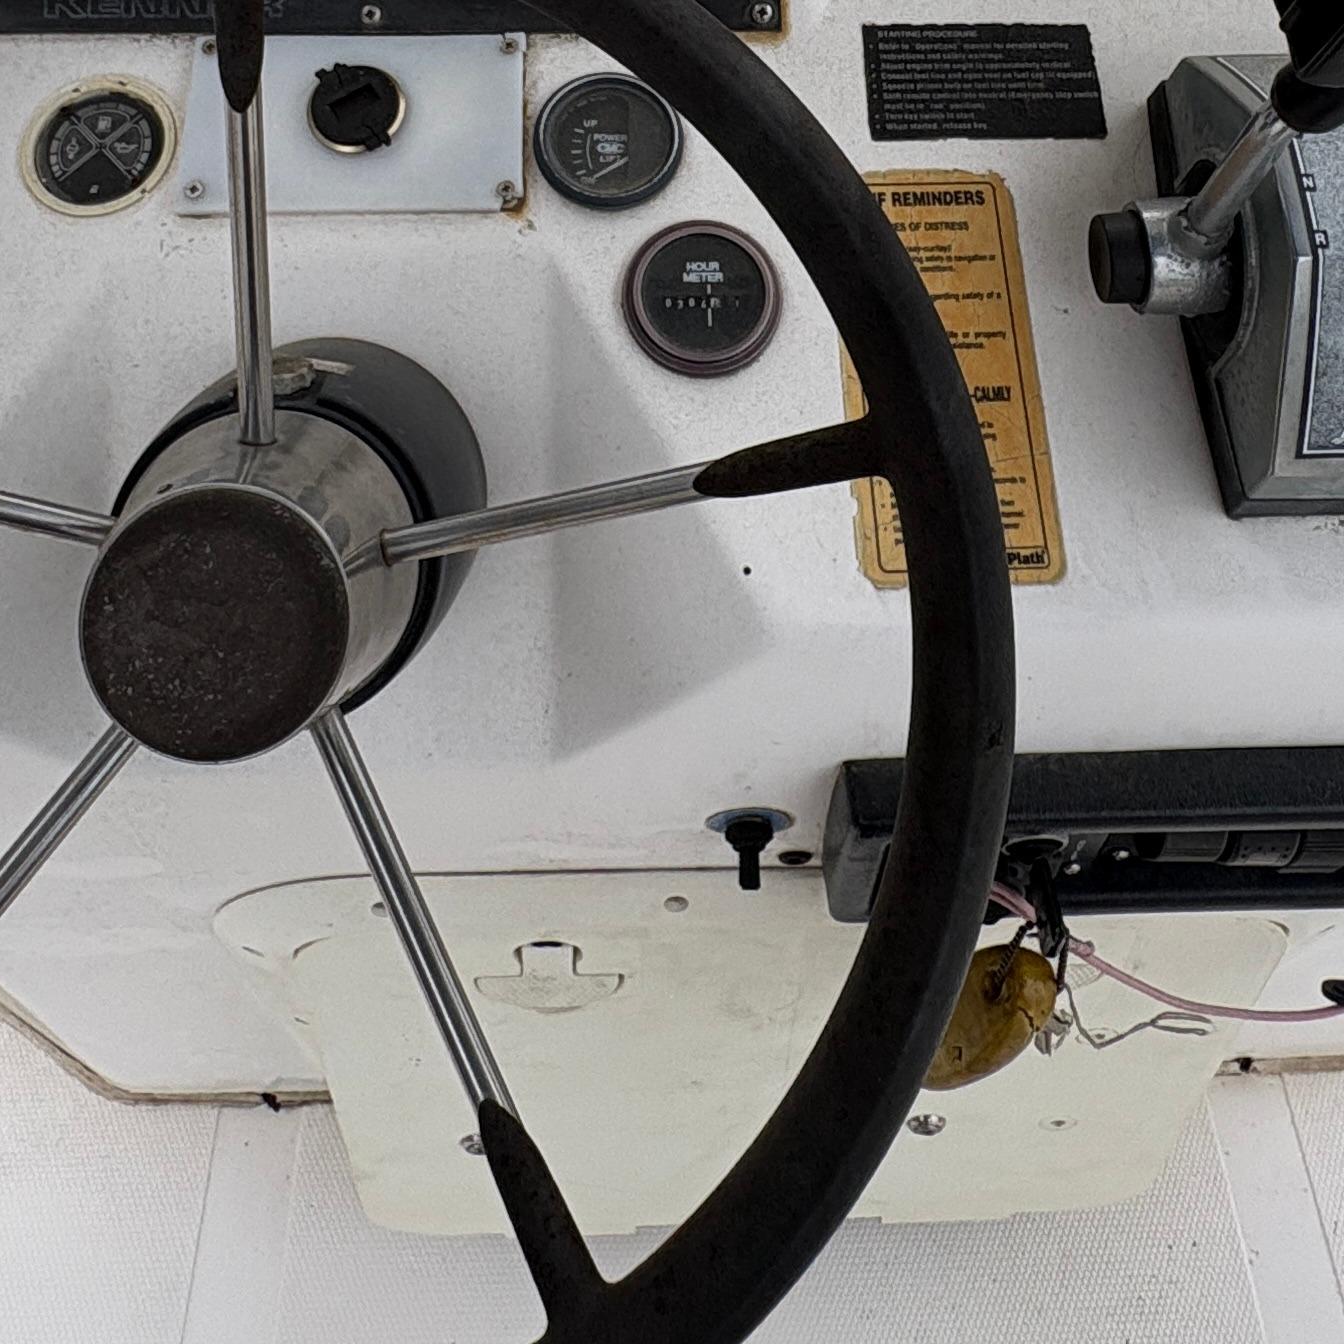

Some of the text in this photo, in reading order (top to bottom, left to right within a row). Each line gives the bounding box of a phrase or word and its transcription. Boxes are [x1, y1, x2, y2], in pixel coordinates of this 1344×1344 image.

[583, 119, 599, 128] UP
[1302, 176, 1314, 188] N
[892, 189, 985, 207] REMINDERS
[908, 222, 921, 232] OF
[924, 221, 970, 232] DISTRESS
[1315, 233, 1326, 245] R
[686, 261, 720, 272] HOUR
[683, 272, 724, 283] METER
[1007, 550, 1045, 566] Plath
